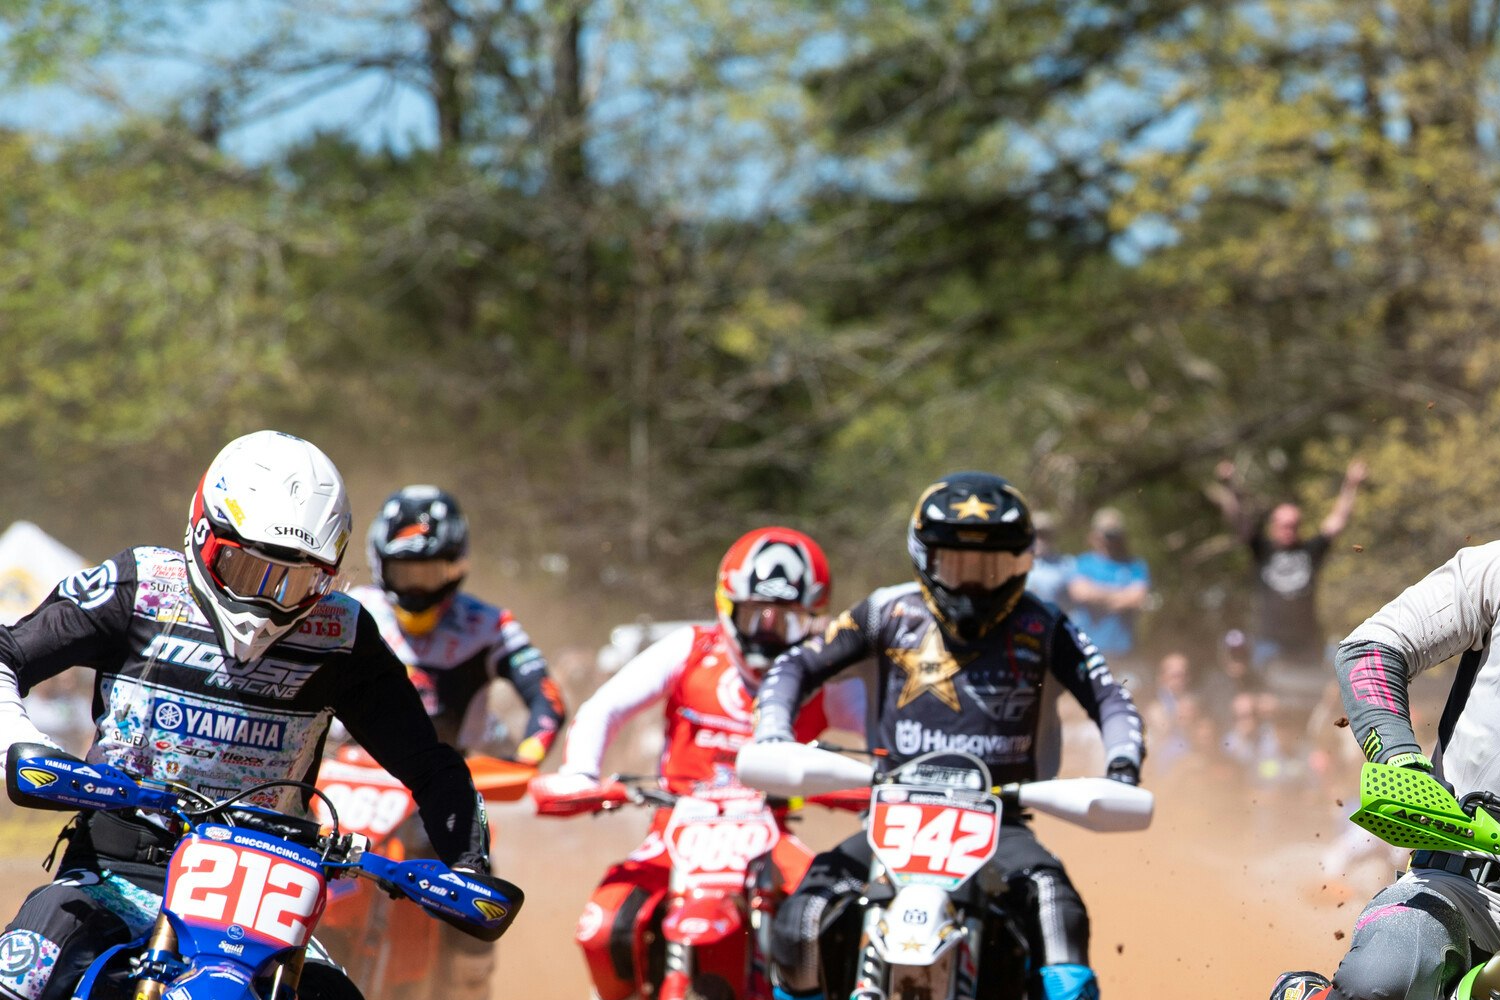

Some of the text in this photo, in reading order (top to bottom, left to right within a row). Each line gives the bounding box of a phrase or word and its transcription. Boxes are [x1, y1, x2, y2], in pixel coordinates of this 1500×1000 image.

[274, 526, 315, 547] SHOEI
[150, 581, 188, 594] SUNEX
[205, 671, 300, 699] RACING
[185, 707, 281, 749] YAMAHA
[44, 759, 72, 772] YAMAHA
[233, 835, 318, 869] GNCCRACING.COM
[882, 804, 996, 873] 342
[169, 841, 321, 947] 212
